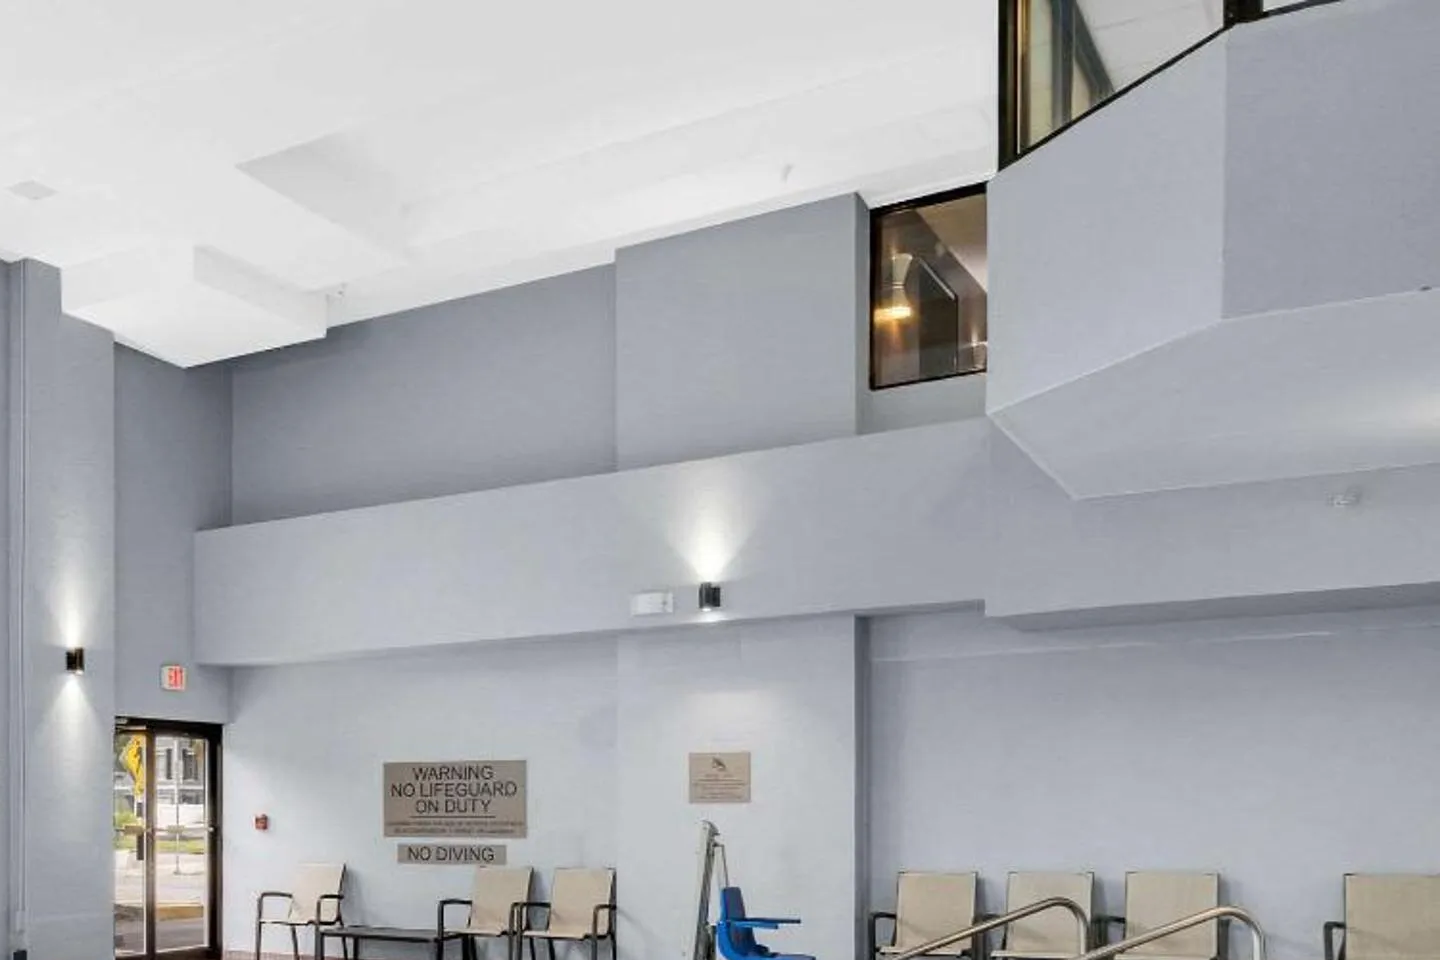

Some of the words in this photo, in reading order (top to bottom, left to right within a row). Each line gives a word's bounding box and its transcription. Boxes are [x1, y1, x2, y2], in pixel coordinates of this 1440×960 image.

[412, 765, 494, 781] WARNING
[391, 783, 416, 798] NO
[420, 781, 517, 798] LIFEGUARD
[416, 799, 439, 814] ON
[445, 798, 491, 814] DUTY
[408, 846, 431, 861] NO
[436, 845, 495, 863] DIVING
